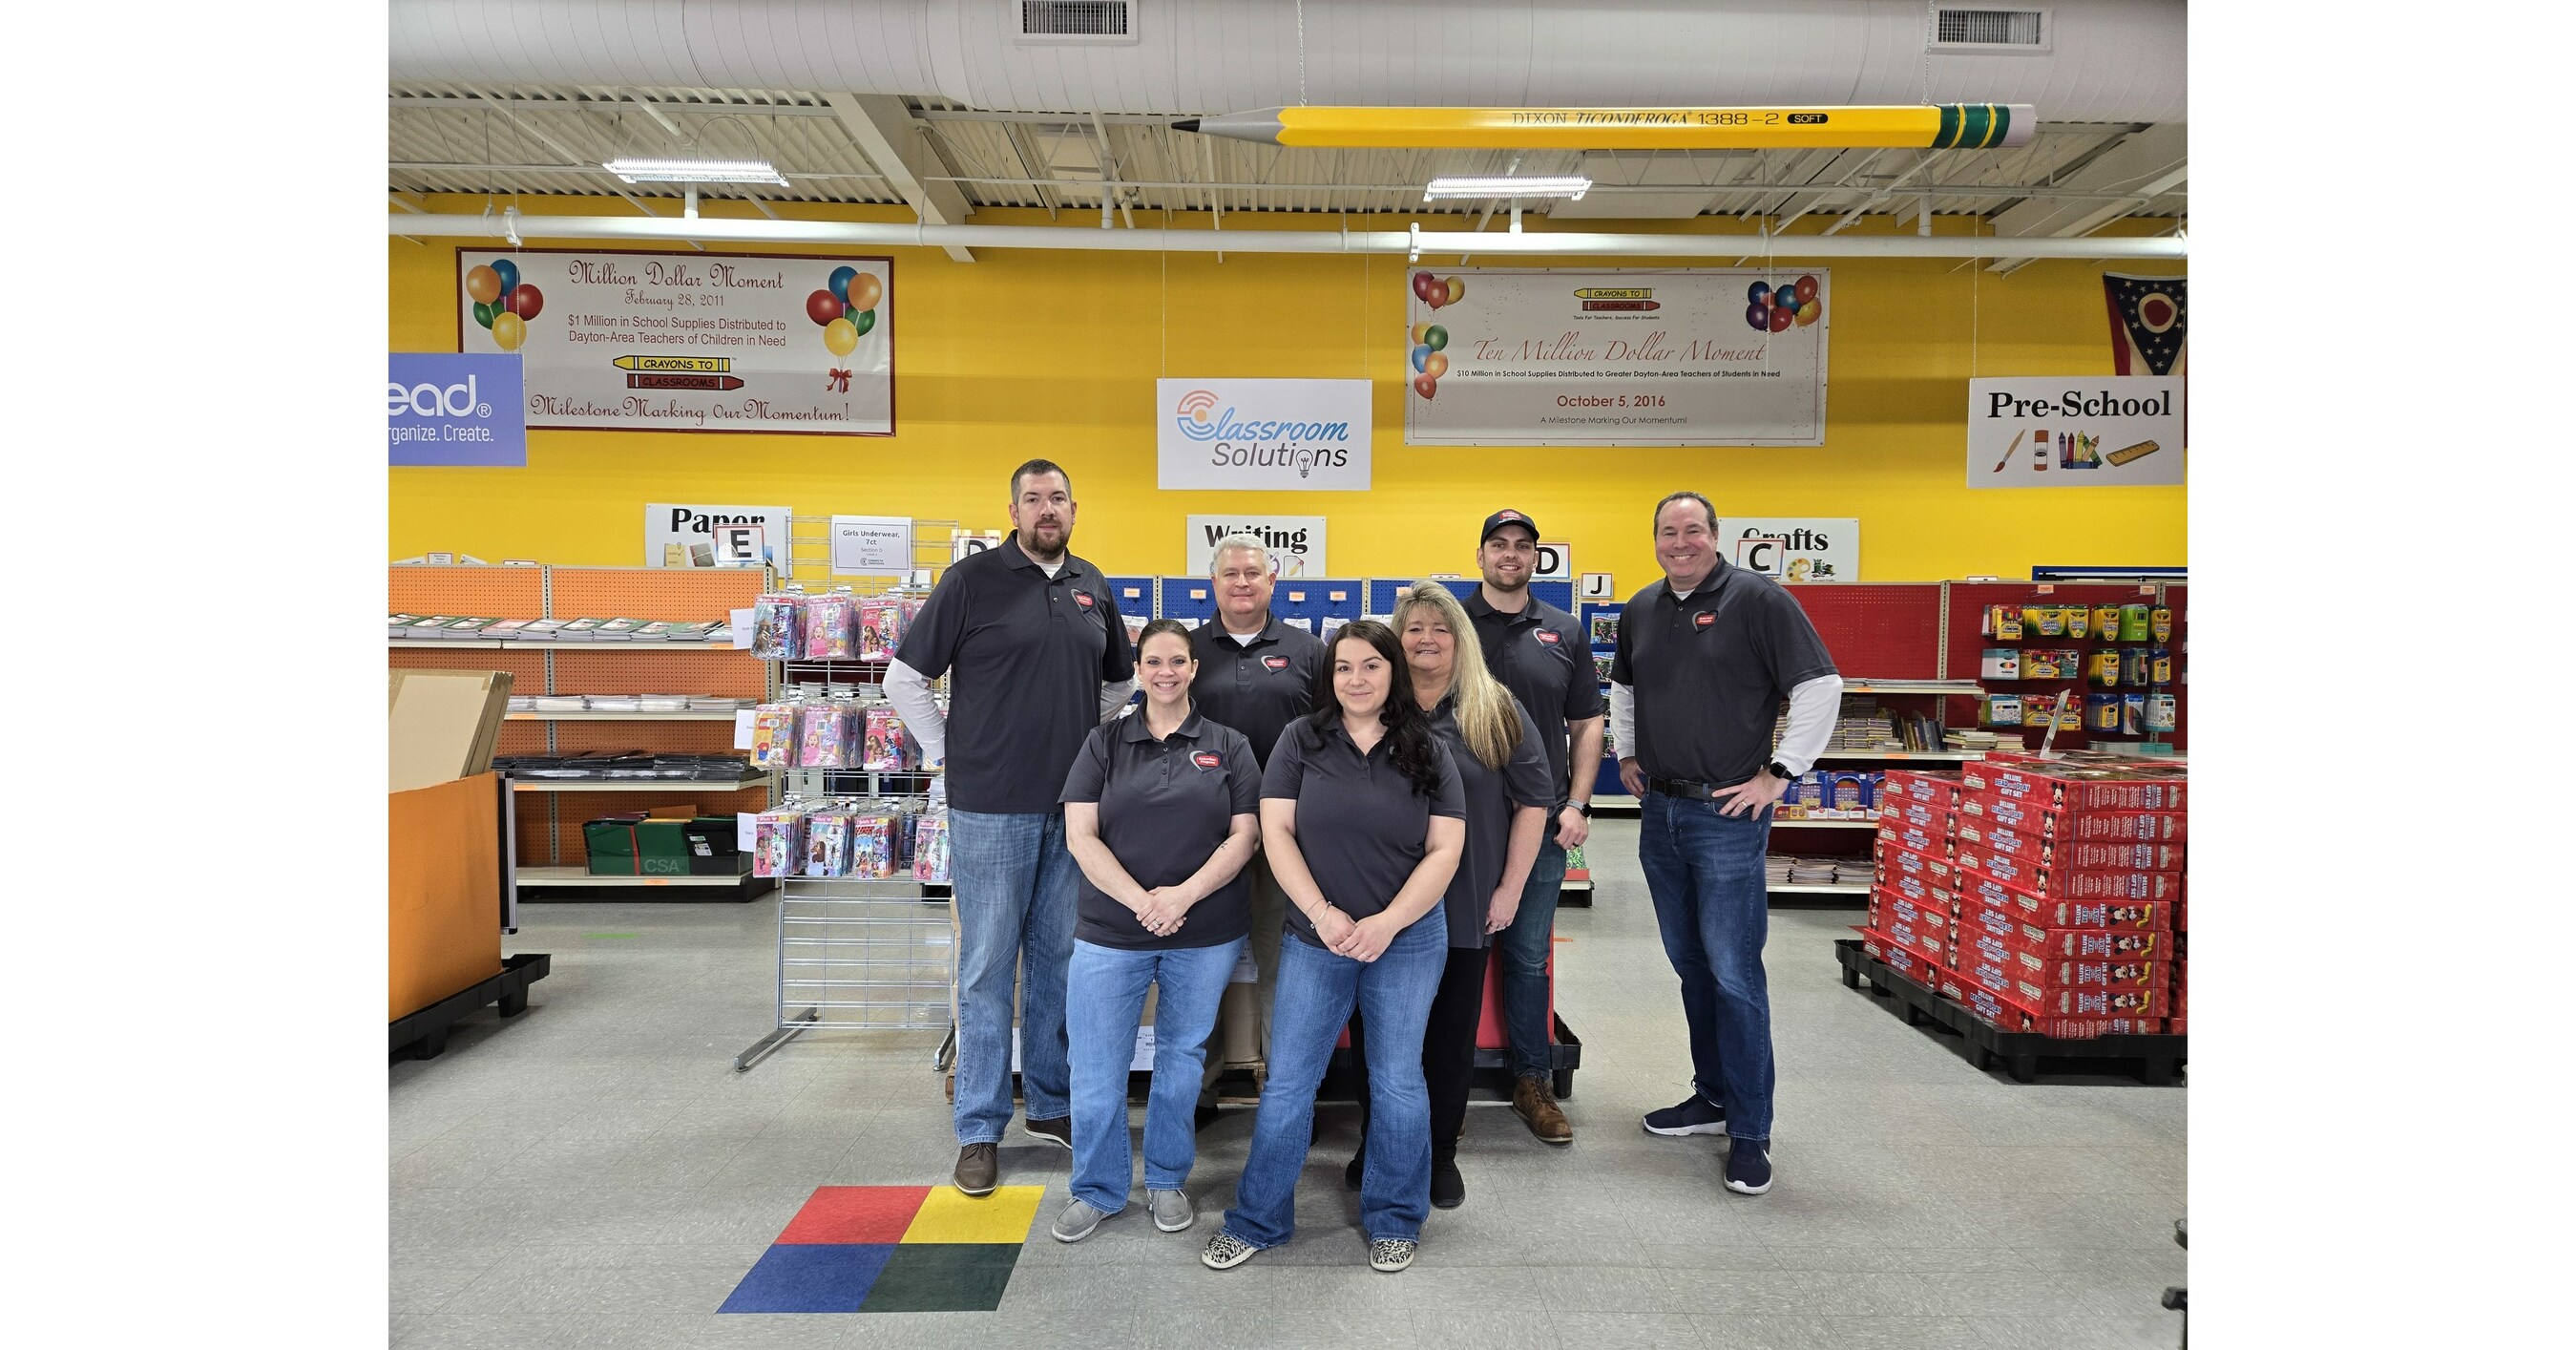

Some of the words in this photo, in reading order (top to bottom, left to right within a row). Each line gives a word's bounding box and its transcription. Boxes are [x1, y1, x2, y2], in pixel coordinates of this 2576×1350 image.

[1512, 113, 1567, 124] DIXON
[1793, 115, 1822, 124] SOFT
[569, 260, 638, 285] Million
[645, 262, 702, 286] Dollar
[710, 264, 784, 288] Moment
[625, 288, 673, 311] February
[678, 294, 695, 307] 28,
[700, 294, 724, 306] 2011
[568, 314, 580, 327] $1
[584, 315, 617, 327] Million
[620, 316, 629, 327] in
[632, 316, 668, 328] School
[671, 317, 716, 331] Supplies
[719, 318, 773, 330] Distributed
[776, 320, 786, 331] to
[569, 331, 635, 345] Dayton-Area
[638, 332, 685, 344] Teachers
[688, 333, 698, 345] of
[701, 333, 743, 346] Children
[747, 335, 756, 346] in
[759, 335, 786, 346] Need
[1473, 337, 1508, 361] Ten
[1511, 331, 1600, 362] Million
[1603, 331, 1675, 361] Dollar
[1680, 339, 1767, 362] Moment
[644, 359, 694, 369] CRAYONS
[698, 360, 713, 370] TO
[1528, 370, 1557, 380] Supplies
[1634, 370, 1678, 380] Dayton-Area
[642, 377, 715, 388] CLASSROOMS
[1557, 395, 1614, 407] October
[1618, 395, 1630, 409] 5,
[1634, 395, 1665, 407] 2016
[1987, 390, 2171, 418] Pre-School
[530, 395, 621, 417] Milestone
[622, 396, 706, 426] Marking
[713, 403, 742, 419] Our
[743, 399, 850, 422] Momentum!
[1588, 417, 1620, 425] Marking
[444, 424, 494, 442] Create.
[730, 530, 752, 558] E
[1536, 547, 1559, 574] D
[1749, 543, 1772, 571] C
[1590, 576, 1602, 594] J
[1994, 778, 2009, 787] READ
[2016, 783, 2031, 792] PLAY
[2003, 773, 2022, 783] DELUXE
[2000, 788, 2012, 796] GIFT
[2013, 790, 2023, 798] SET
[1991, 804, 2004, 814] READ
[1997, 815, 2008, 823] GIFT
[2008, 817, 2017, 826] SET
[1989, 832, 2002, 841] READ
[1994, 842, 2005, 850] GIFT
[2005, 844, 2015, 853] SET
[644, 859, 681, 873] CSA
[1987, 859, 1999, 869] READ
[1991, 869, 2002, 878] GIFT
[2002, 872, 2011, 881] SET
[1970, 993, 1982, 1004] READ
[1975, 1004, 1986, 1014] GIFT
[1986, 1009, 1995, 1018] SET
